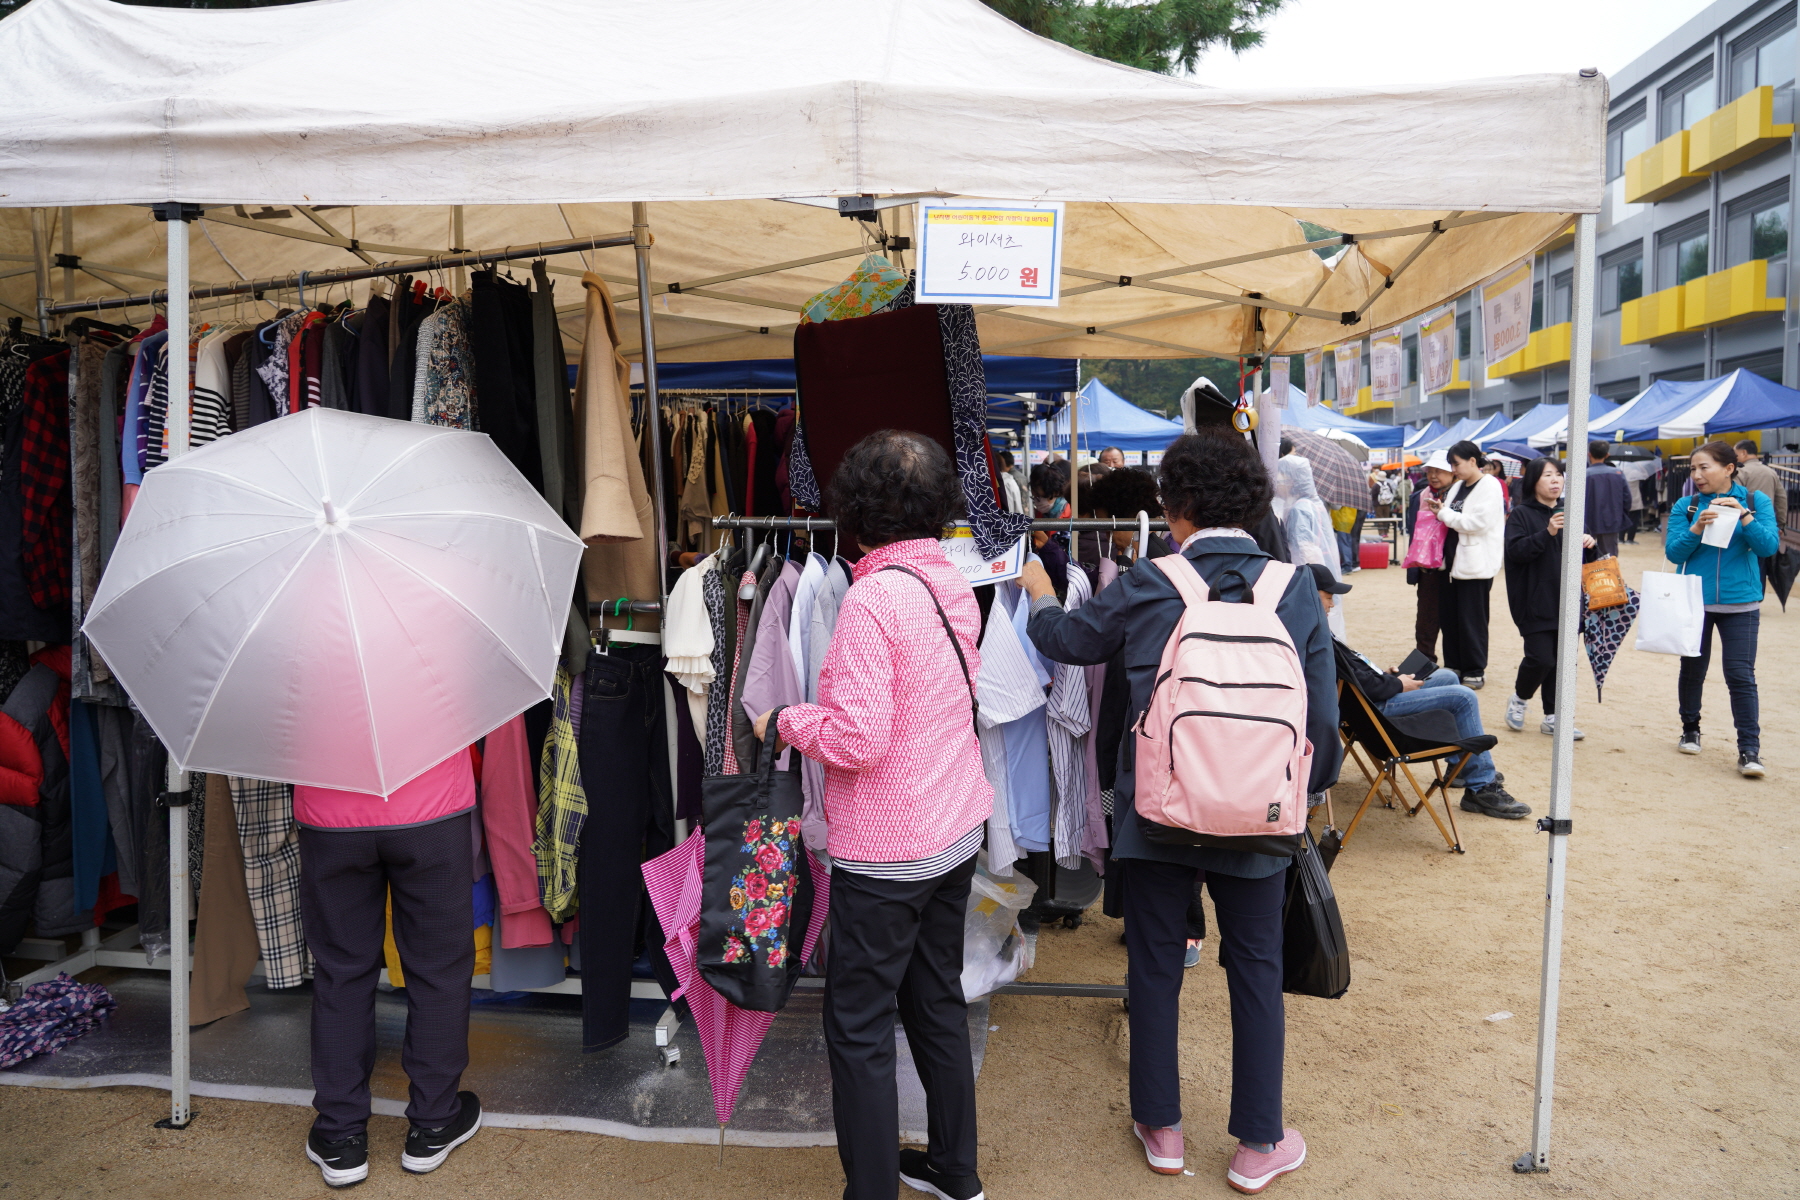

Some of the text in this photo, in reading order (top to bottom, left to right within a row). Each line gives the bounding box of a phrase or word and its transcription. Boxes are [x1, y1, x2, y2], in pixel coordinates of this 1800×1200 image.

[958, 232, 1023, 249] 와이셔츠
[1019, 266, 1039, 288] 원
[991, 561, 1006, 573] 원
